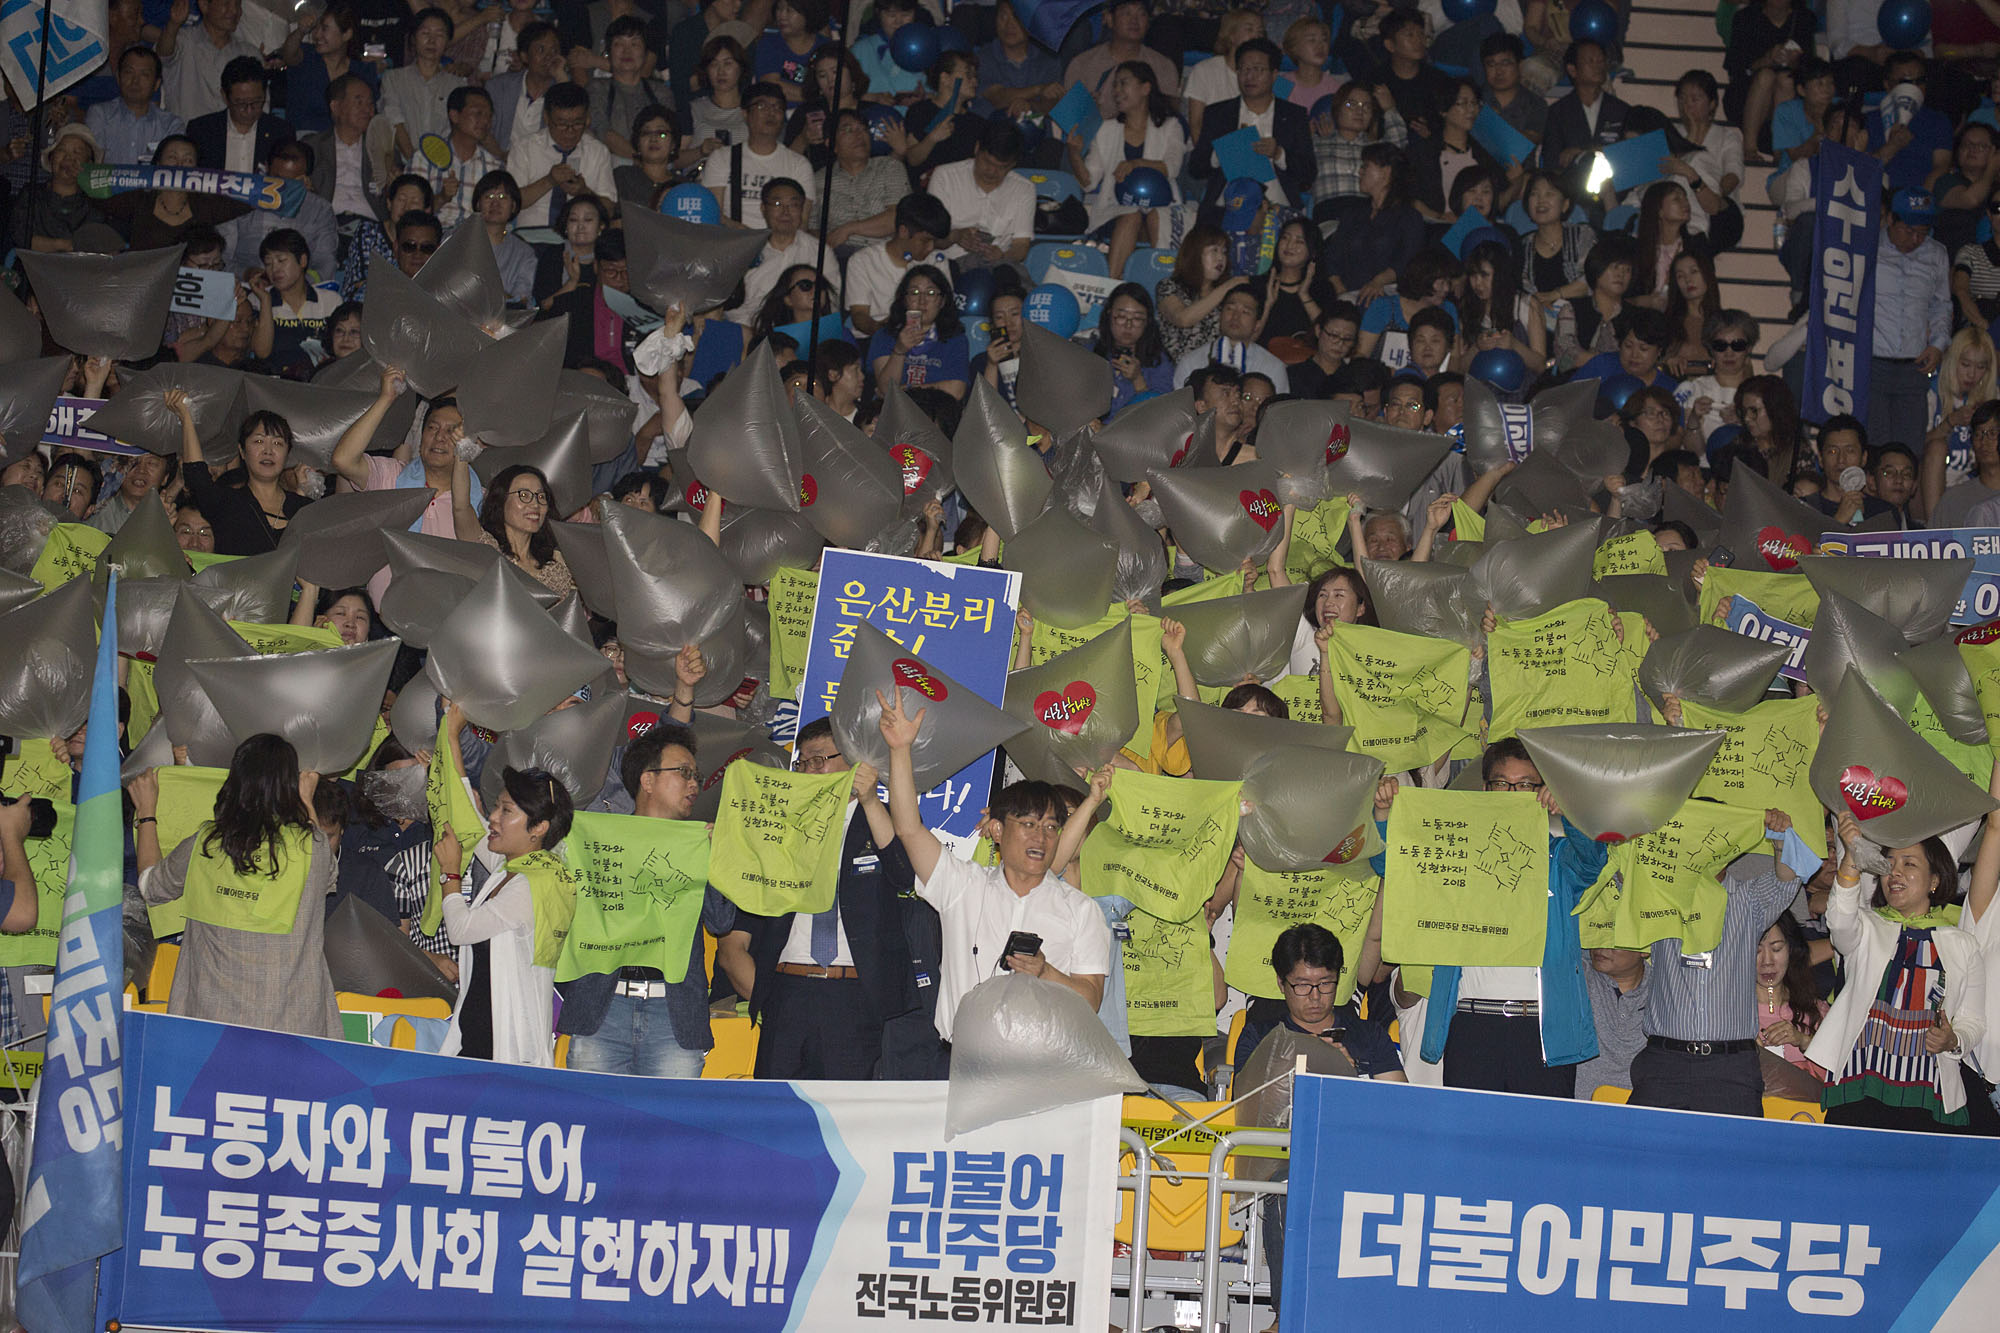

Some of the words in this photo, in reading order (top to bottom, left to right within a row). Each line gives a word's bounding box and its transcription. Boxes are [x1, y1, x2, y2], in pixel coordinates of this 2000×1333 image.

[257, 176, 286, 210] 3
[786, 591, 815, 603] 더불어
[1534, 632, 1567, 646] 더불어
[1355, 653, 1398, 668] 노동자와
[1043, 696, 1092, 722] 사랑해찬
[1362, 736, 1401, 747] 더불어민주당
[754, 774, 792, 790] 노동자와
[1723, 780, 1745, 789] 2018
[760, 793, 789, 807] 더불어
[1844, 782, 1897, 809] 사랑해찬
[1141, 805, 1186, 820] 노동자와
[1149, 823, 1181, 836] 더불어
[1422, 818, 1469, 831] 노동자와
[1434, 833, 1468, 847] 더불어
[583, 841, 625, 854] 노동자와
[1400, 845, 1468, 860] 노동존중사회
[592, 857, 623, 872] 더불어
[1416, 861, 1467, 876] 실현하자!
[1280, 871, 1326, 883] 노동자와
[1442, 878, 1466, 887] 2018
[1651, 871, 1674, 884] 2018
[216, 885, 260, 901] 더불어민주당
[580, 885, 624, 901] 실현하자!
[1289, 887, 1322, 898] 더불어
[602, 903, 625, 911] 2018
[1252, 894, 1319, 908] 노동존중사회
[1268, 909, 1317, 920] 실현하자!
[1417, 919, 1459, 931] 더불어민주당
[1461, 923, 1509, 935] 전국노동위원회
[579, 941, 622, 952] 더불어민주당
[1133, 1000, 1179, 1009] 전국노동위원회
[148, 1085, 391, 1188] 노동자와
[410, 1111, 597, 1204] 더불어,
[891, 1150, 1065, 1214] 더불어
[139, 1185, 500, 1294] 노동존중사회
[519, 1213, 791, 1308] 실현하자!!
[886, 1210, 1064, 1275] 민주당
[1337, 1190, 1882, 1318] 더불어민주당
[856, 1272, 1077, 1327] 전국노동위원회
